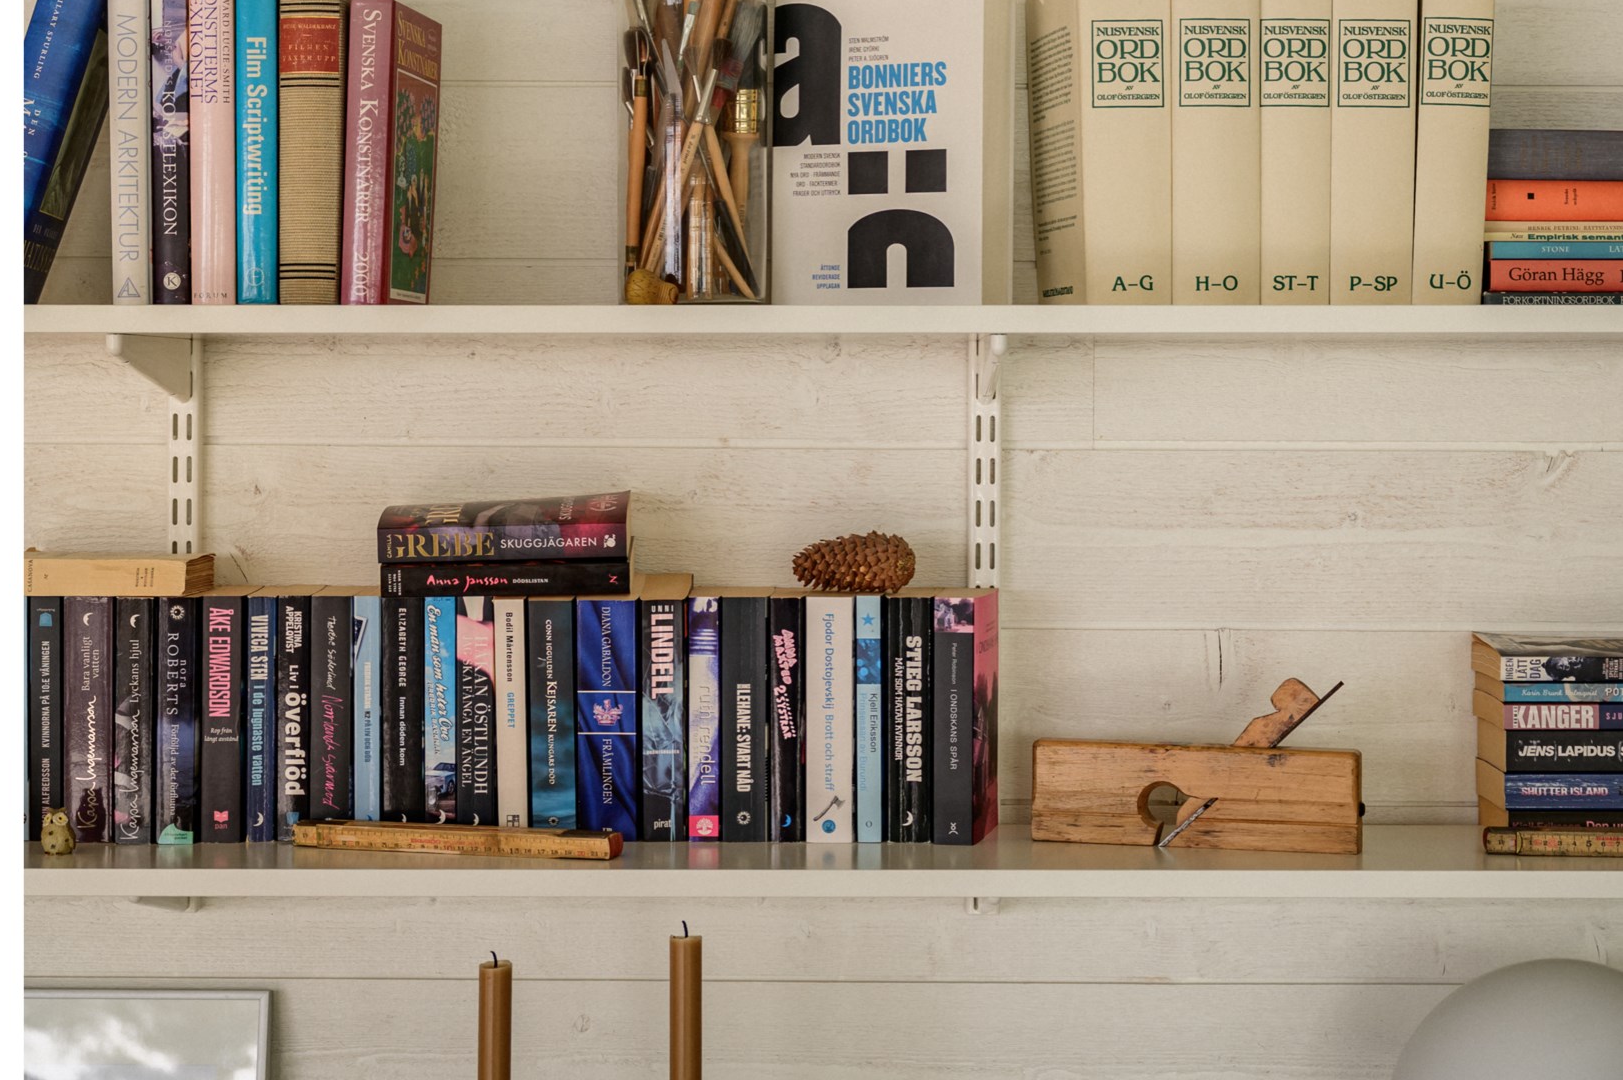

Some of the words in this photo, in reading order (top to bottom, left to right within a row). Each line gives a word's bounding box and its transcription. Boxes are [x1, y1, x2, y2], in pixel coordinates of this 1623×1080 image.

[1096, 26, 1160, 37] NUSVENSK
[1428, 23, 1491, 36] NUSVENSK
[34, 31, 53, 79] SPURLING
[246, 37, 267, 78] Film
[360, 8, 382, 91] SVENSKA
[116, 14, 138, 120] MODERN
[222, 30, 231, 104] LUCIE-SMITH
[848, 61, 947, 90] BONNIERS
[1098, 61, 1161, 83] BOK
[1428, 59, 1489, 82] BOK
[847, 89, 937, 117] SVENSKA
[1096, 93, 1117, 101] OLOF
[1117, 92, 1161, 101] ÖSTERGREN
[28, 109, 41, 135] DEN
[847, 118, 927, 145] ORDBOK
[162, 91, 177, 236] KONSTLEXIKON
[242, 83, 268, 216] Scriptwriting
[354, 97, 378, 223] KONSTNÄRER
[118, 129, 140, 262] ARKITEKTUR
[1528, 233, 1579, 241] Empirisk
[354, 252, 370, 297] 2000
[1509, 267, 1557, 281] Göran
[1562, 267, 1605, 286] Hägg
[393, 531, 495, 558] GREBE
[500, 536, 597, 549] SKUGGJÄGAREN
[427, 574, 460, 586] Anna
[463, 575, 508, 593] Jansson
[209, 607, 234, 632] ÅKE
[250, 614, 269, 652] VIVECA
[285, 605, 295, 654] APPELQVIST
[293, 611, 303, 648] KRISTINA
[399, 607, 407, 652] ELIZABETH
[506, 612, 514, 634] Bodil
[602, 606, 611, 634] DIANA
[823, 613, 835, 646] Fjodor
[39, 640, 50, 677] VÅNINGEN
[81, 636, 92, 669] vanligt
[92, 649, 100, 679] vatten
[129, 639, 142, 660] hjul
[506, 635, 515, 682] Mårtensson
[602, 636, 612, 687] GABALDON
[650, 613, 674, 700] LINDELL
[905, 636, 922, 692] STIEG
[81, 670, 91, 691] Bara
[129, 663, 140, 703] Lyckans
[167, 632, 179, 716] ROBERTS
[208, 635, 231, 718] EDWARDSON
[250, 655, 269, 680] STEN
[288, 664, 299, 682] Liv
[399, 654, 407, 688] GEORGE
[822, 648, 834, 710] Dostojevskij
[1505, 657, 1514, 680] INGEN
[1515, 659, 1528, 680] LÄTT
[1529, 658, 1542, 679] DAG
[40, 695, 50, 705] PÅ
[41, 678, 50, 693] 10:E
[868, 693, 878, 711] Kjell
[1521, 689, 1540, 697] Karin
[507, 692, 516, 729] GREPPET
[737, 689, 751, 733] LEHANE:
[950, 693, 958, 743] ONDSKANS
[1516, 705, 1594, 730] KANGER
[41, 707, 50, 748] KVINNORNA
[250, 708, 265, 751] lugnaste
[284, 692, 307, 796] överflöd
[399, 719, 407, 747] döden
[825, 714, 834, 741] Brott
[869, 714, 878, 753] Eriksson
[905, 696, 922, 782] LARSSON
[474, 702, 492, 795] ÖSTLUNDH
[737, 734, 751, 767] SVART
[950, 745, 959, 770] SPÅR
[1518, 746, 1555, 757] JENS
[1558, 746, 1615, 757] LAPIDUS
[42, 758, 50, 805] ALFREDSSON
[251, 754, 263, 786] vatten
[462, 747, 475, 788] ÄNGEL
[602, 738, 613, 805] FRÄMLINGEN
[737, 770, 754, 792] NÅD
[825, 762, 835, 791] straff
[1521, 787, 1568, 796] SHUTTER
[1570, 787, 1608, 796] ISLAND
[653, 819, 672, 829] pirat
